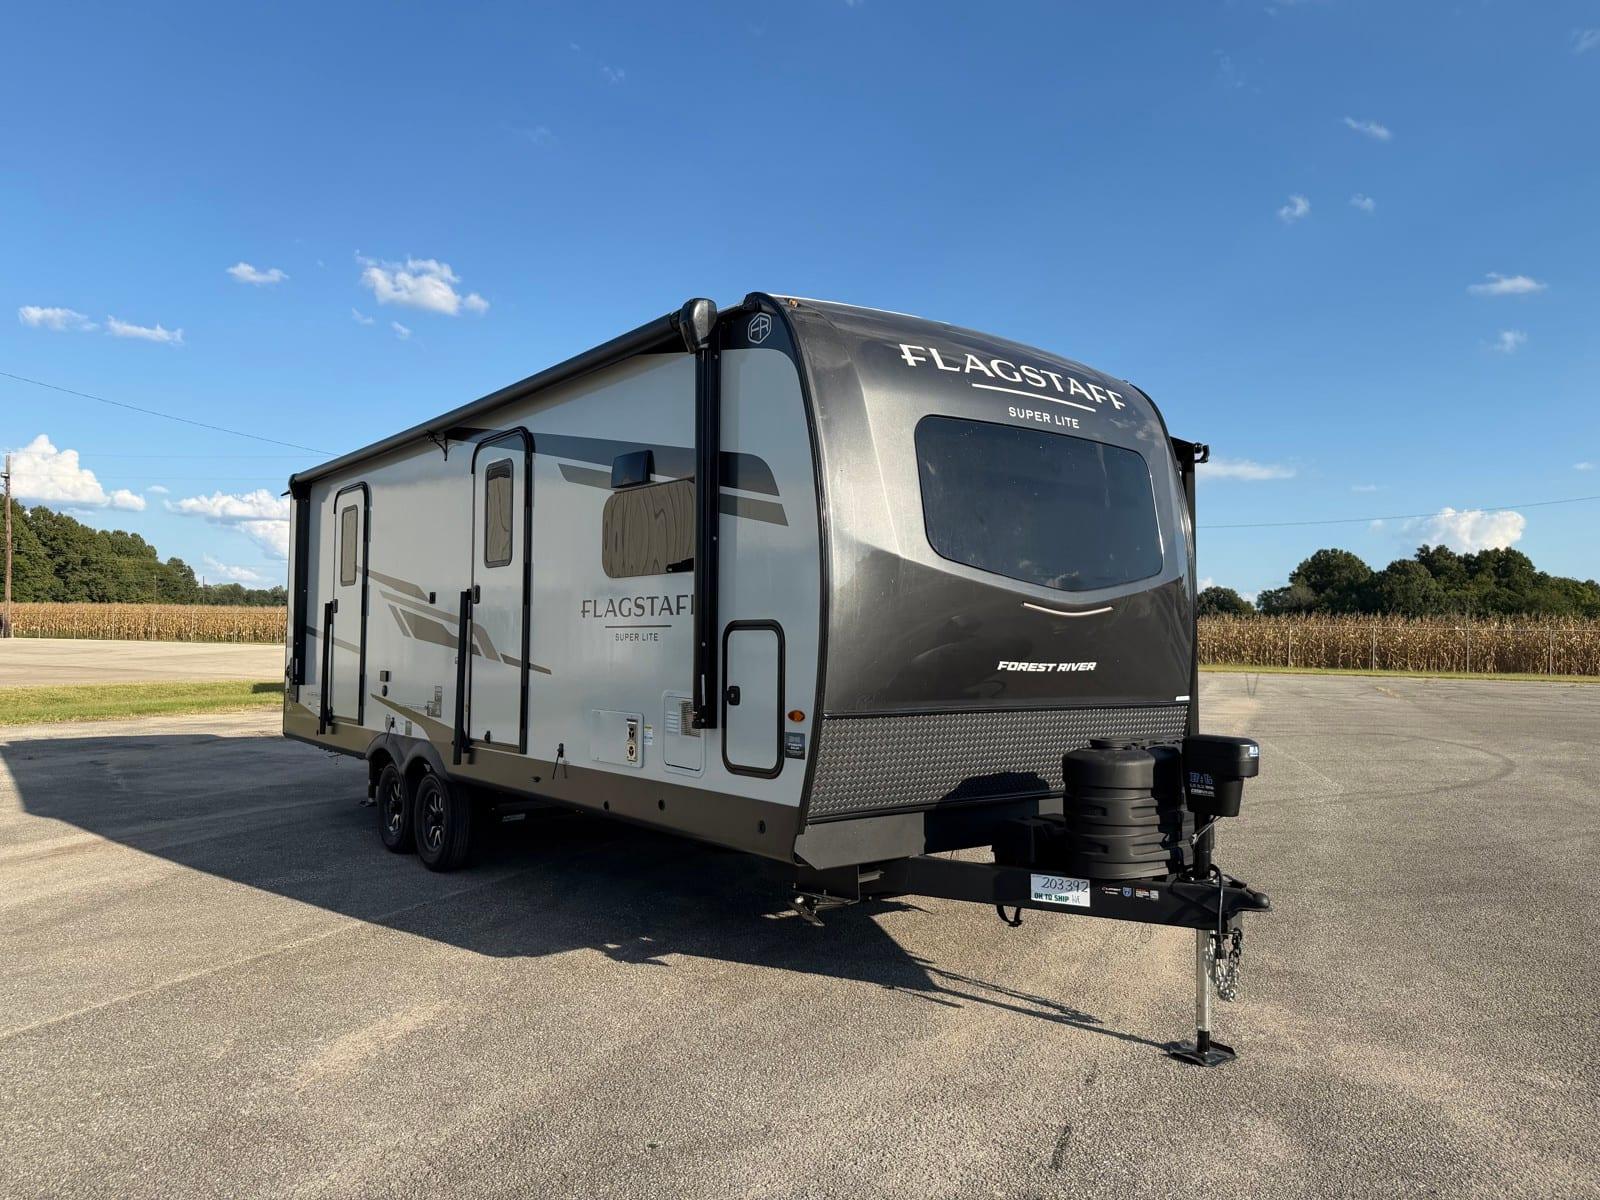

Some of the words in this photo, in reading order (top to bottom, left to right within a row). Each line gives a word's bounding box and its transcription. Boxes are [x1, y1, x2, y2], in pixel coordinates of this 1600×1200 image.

[899, 343, 1126, 410] FLAGSTAFF
[1008, 406, 1051, 424] SUPER
[1055, 415, 1080, 429] LITE
[615, 632, 640, 642] SUPER
[642, 632, 659, 642] LITE
[997, 661, 1056, 672] FOREST
[1057, 661, 1097, 672] RIVER
[1040, 876, 1089, 893] 203392
[1045, 893, 1053, 901] TO
[1054, 894, 1070, 902] SHIP
